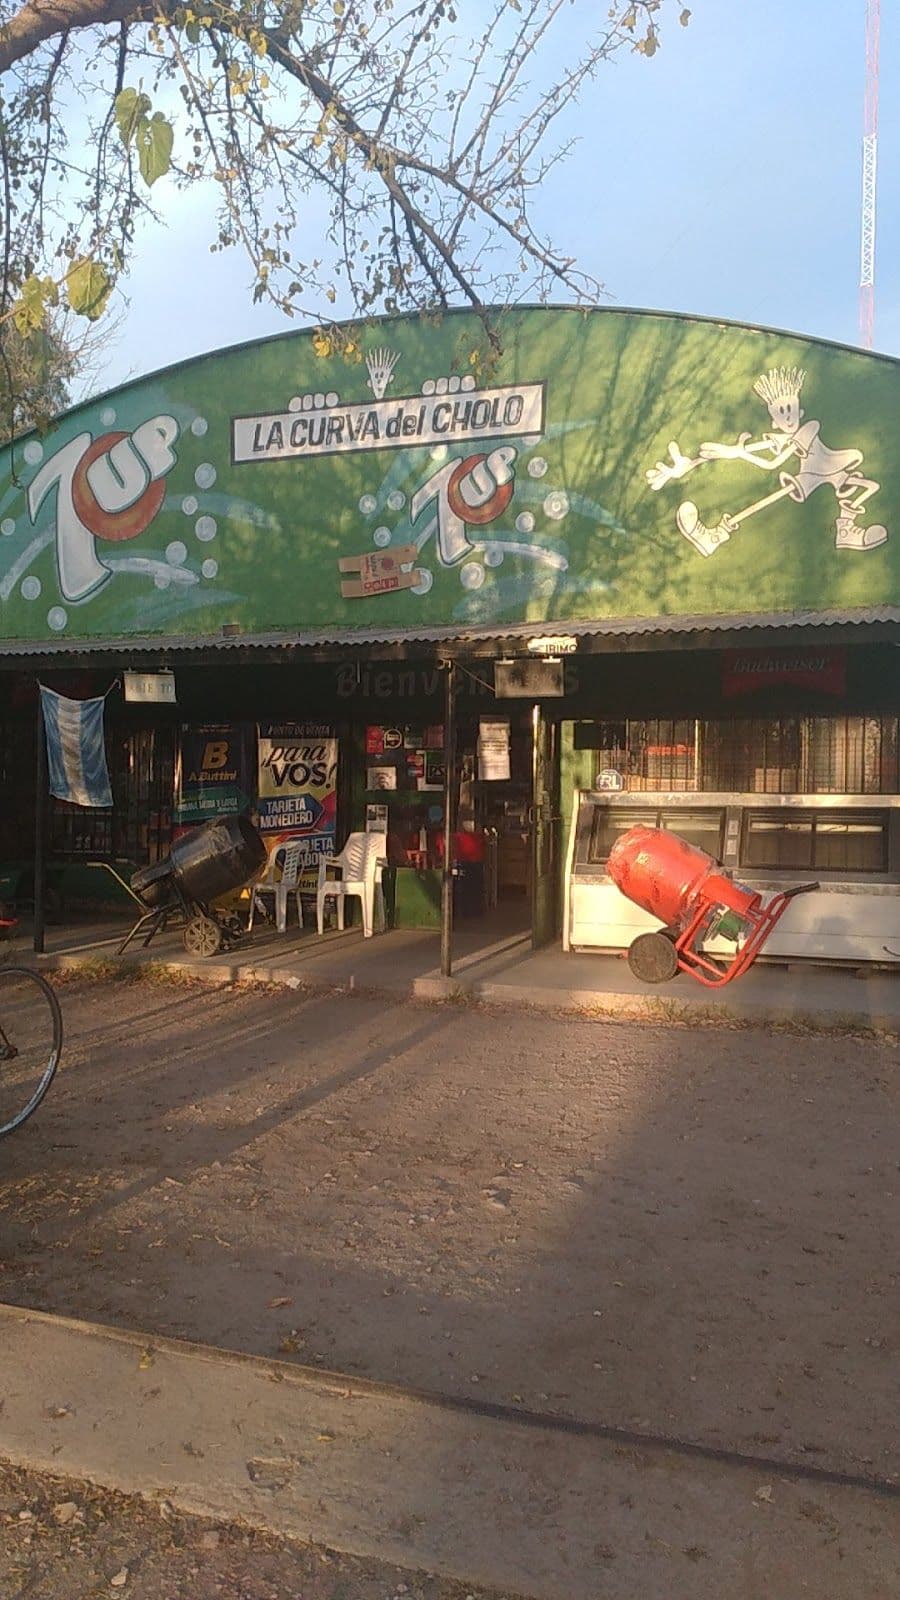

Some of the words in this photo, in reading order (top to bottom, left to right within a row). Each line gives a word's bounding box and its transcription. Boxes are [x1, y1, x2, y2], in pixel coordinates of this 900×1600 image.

[252, 421, 284, 452] LA
[289, 410, 381, 447] CURVA
[385, 405, 425, 437] del
[431, 394, 525, 434] CHOLO
[271, 762, 338, 789] VOS!
[266, 797, 307, 815] TARJETA
[259, 810, 314, 829] MONEDERO
